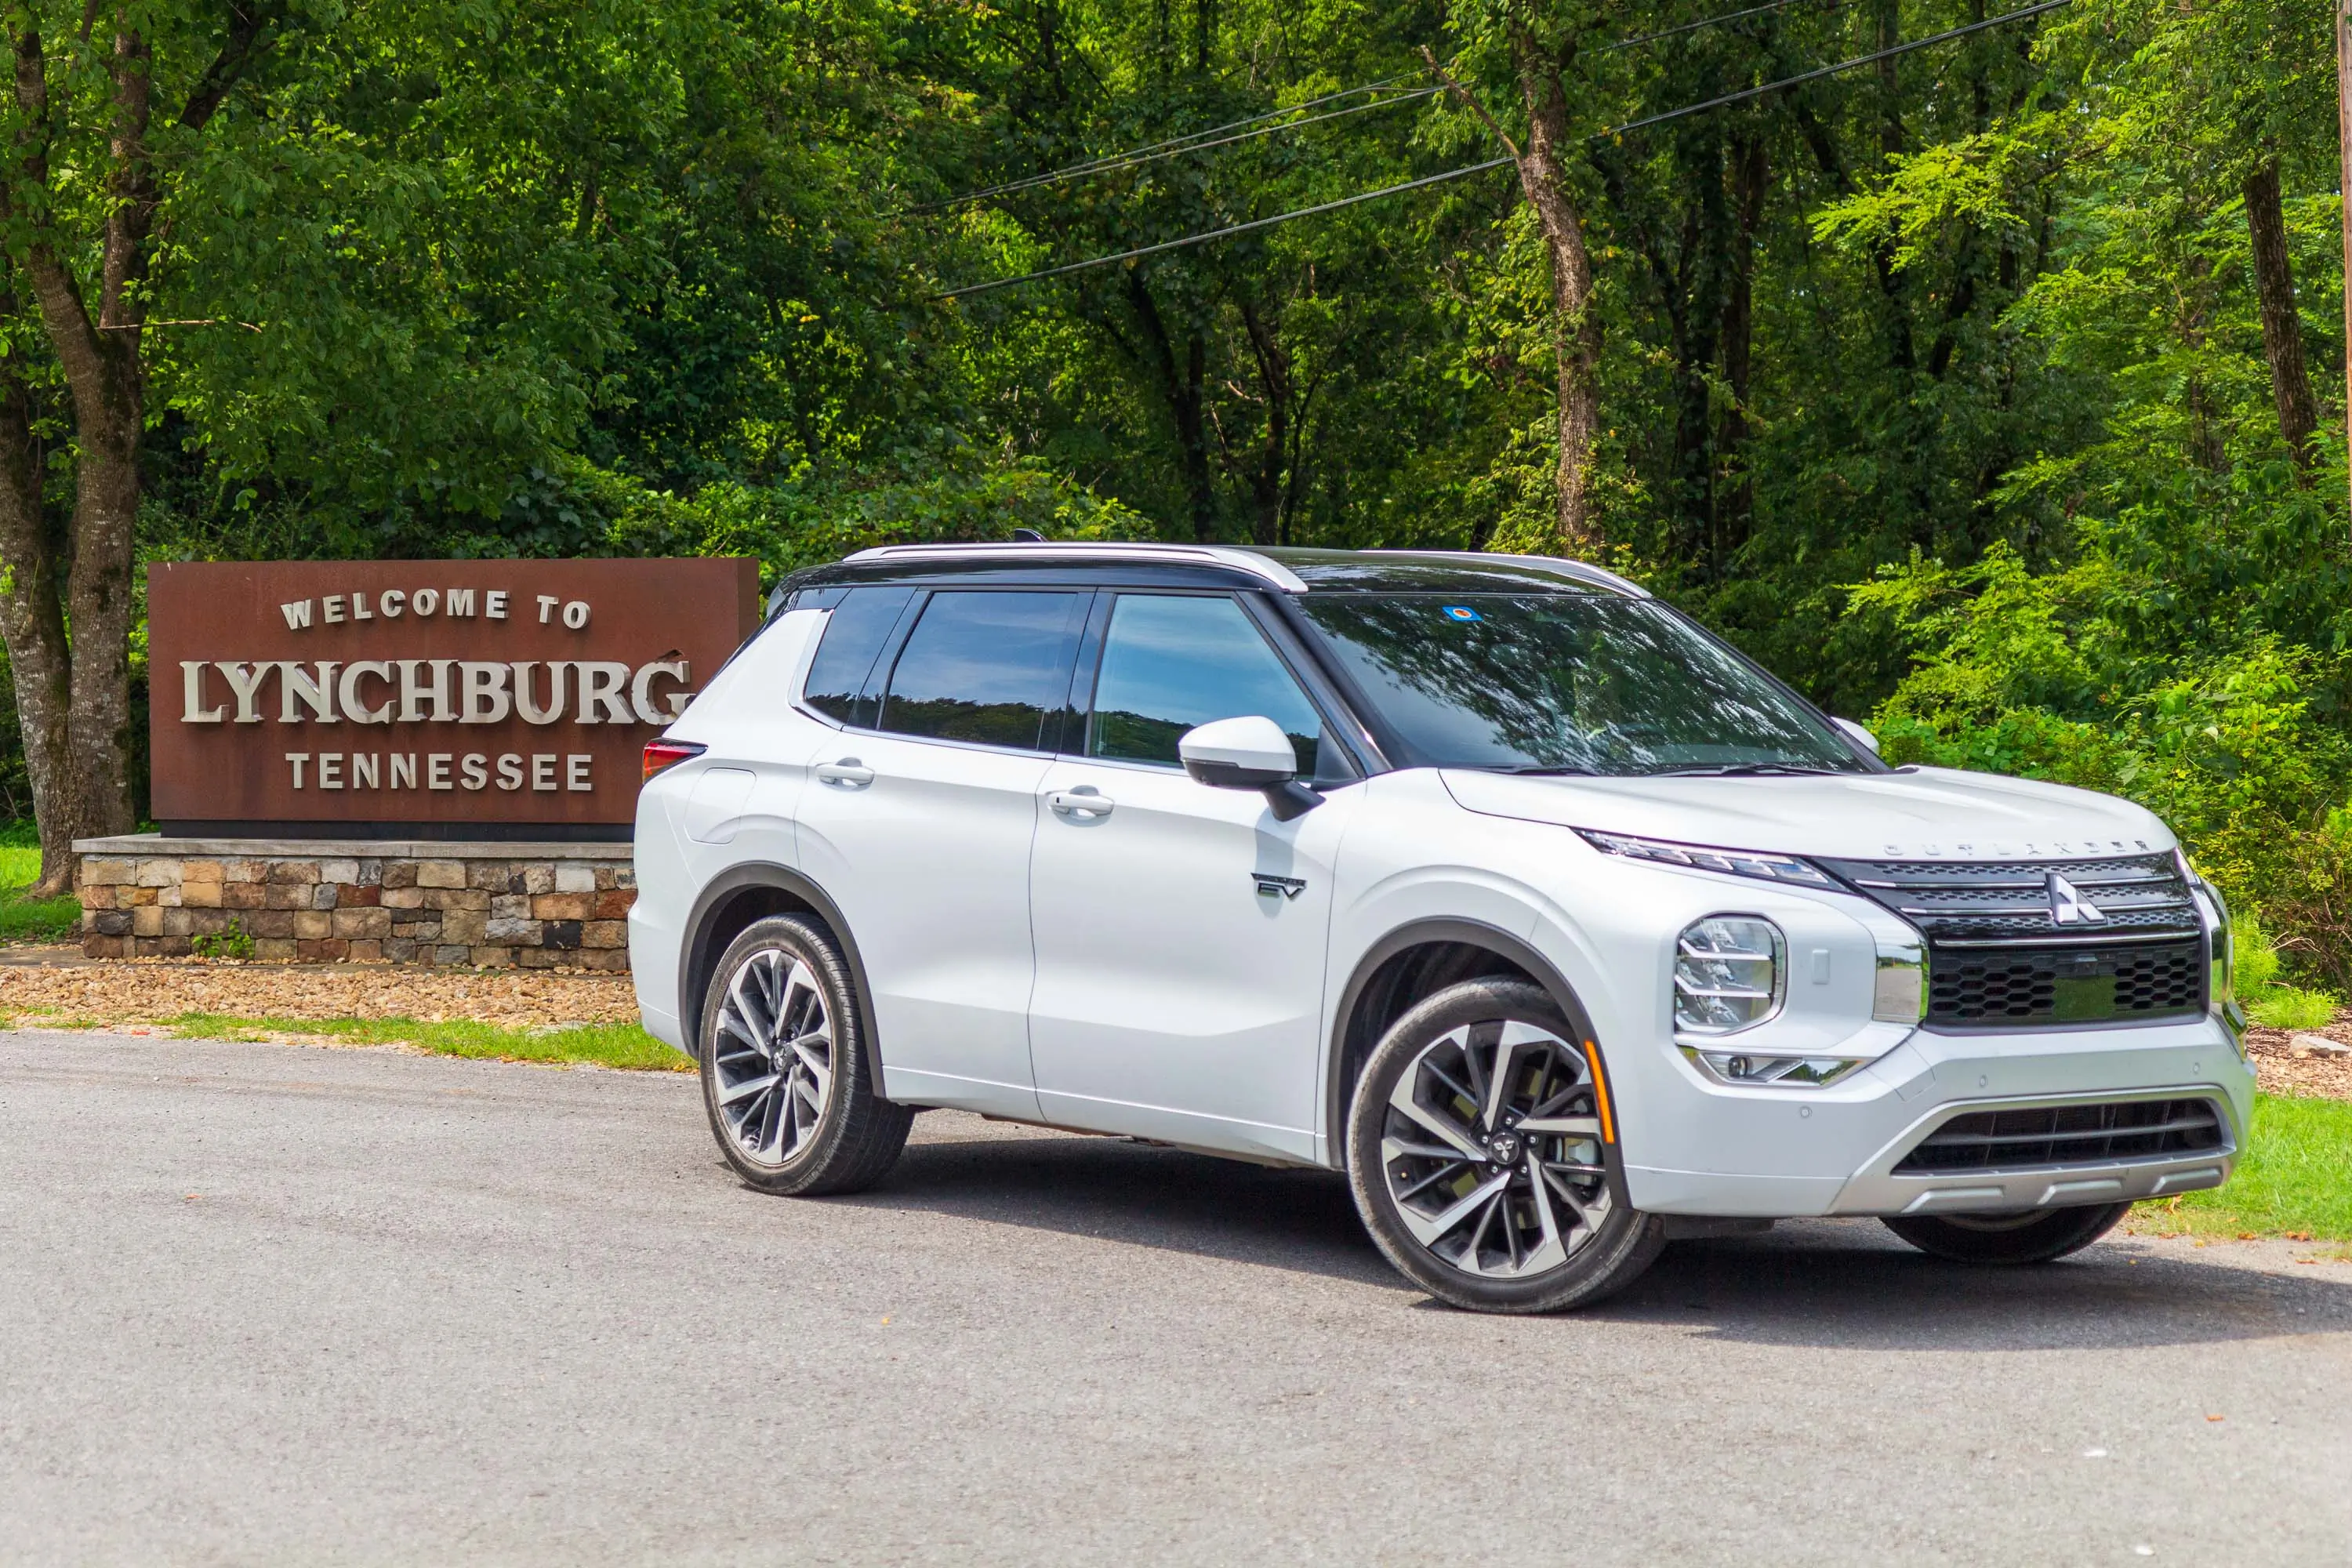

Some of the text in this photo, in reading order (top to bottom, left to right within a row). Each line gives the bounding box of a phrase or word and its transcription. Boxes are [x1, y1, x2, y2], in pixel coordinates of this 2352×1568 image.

[281, 589, 593, 630] WELCOME TO
[180, 659, 695, 726] LYNCHBURG
[285, 753, 593, 792] TENNESSEE
